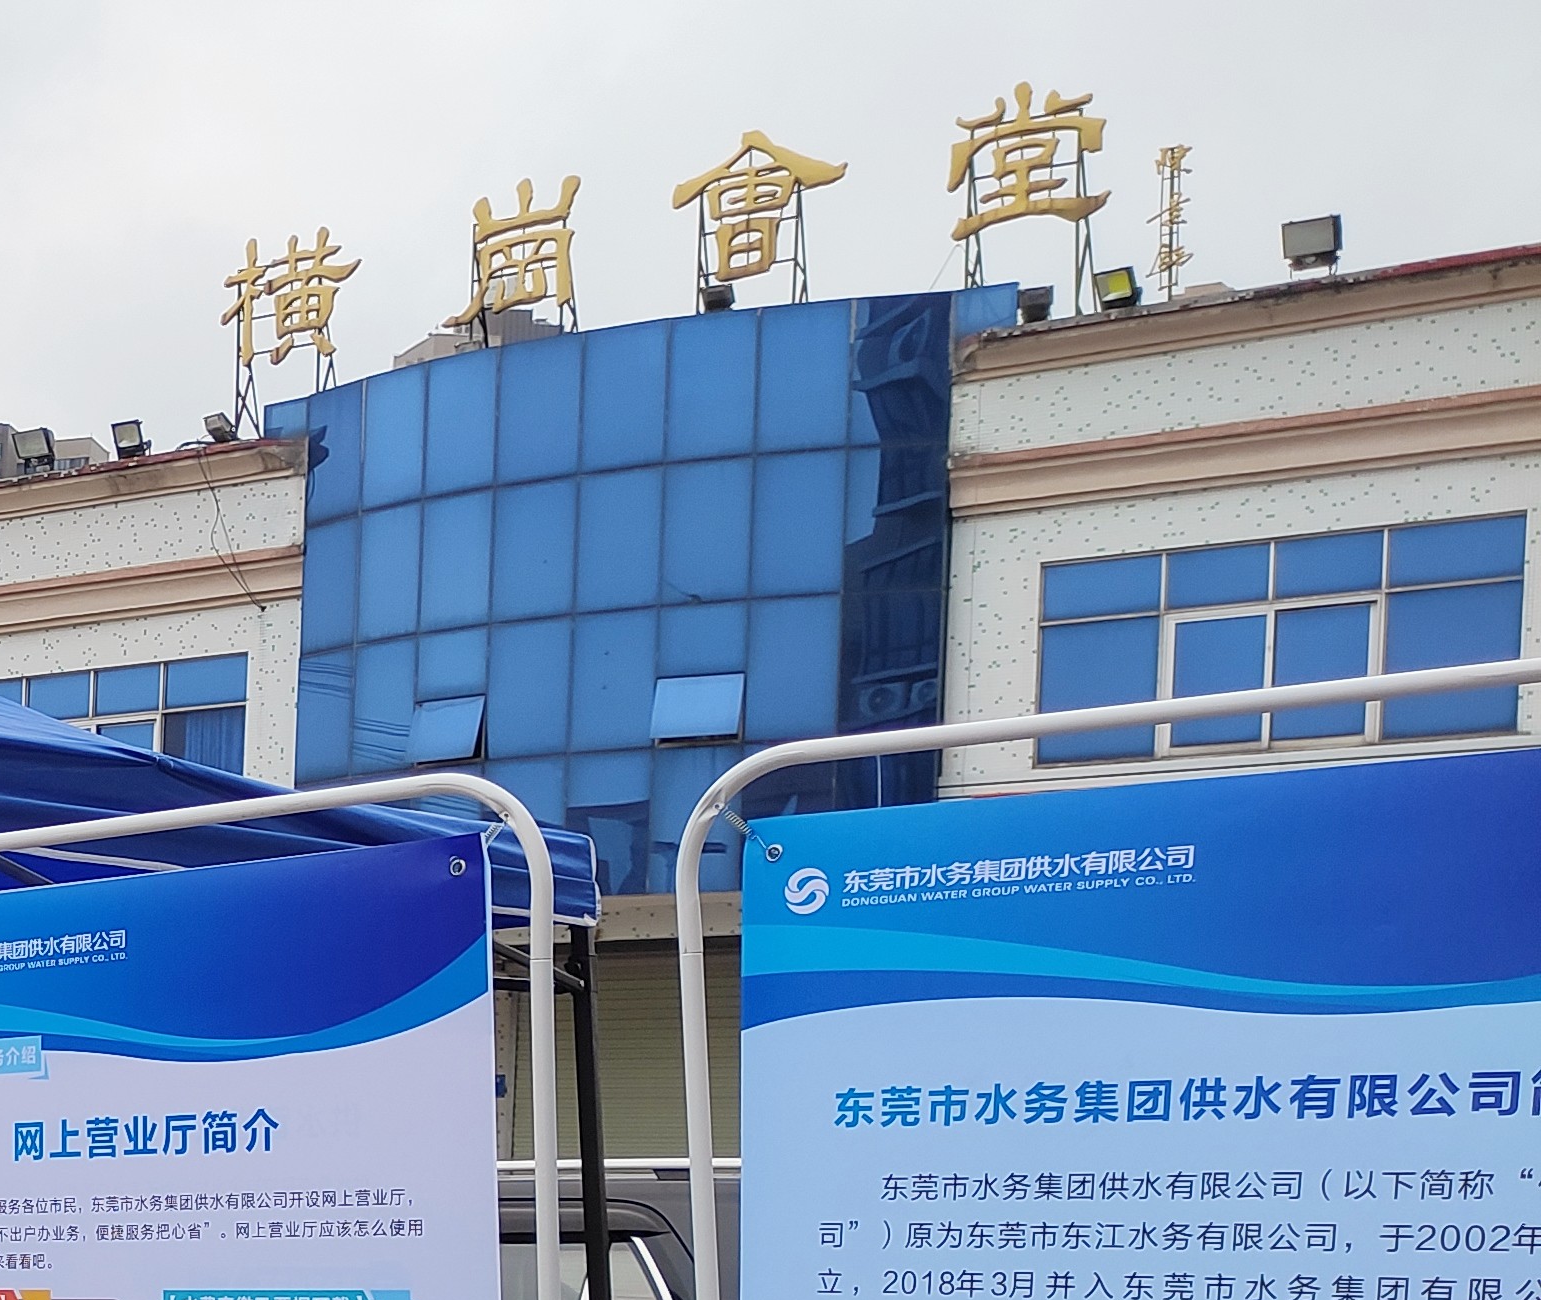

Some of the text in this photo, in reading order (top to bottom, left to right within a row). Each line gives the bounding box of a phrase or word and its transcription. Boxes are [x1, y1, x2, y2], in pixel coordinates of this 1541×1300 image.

[842, 844, 1195, 893] 东莞市水务集团供水有限公司
[841, 893, 917, 908] DONGGUAN
[921, 888, 967, 902] WATER
[972, 885, 1019, 898] GROUP
[1024, 881, 1073, 894] WATER
[1076, 877, 1130, 891] SUPPLY
[1167, 873, 1196, 884] LTD.
[27, 958, 56, 970] WATER
[58, 955, 89, 966] SUPPLY
[110, 950, 128, 960] LTD.
[832, 1068, 1541, 1129] 东莞市水务集团供水有限公司
[13, 1108, 280, 1162] 网上营业厅简介
[880, 1167, 1541, 1203] 东莞市水务集团供水有限公司（以下简称“
